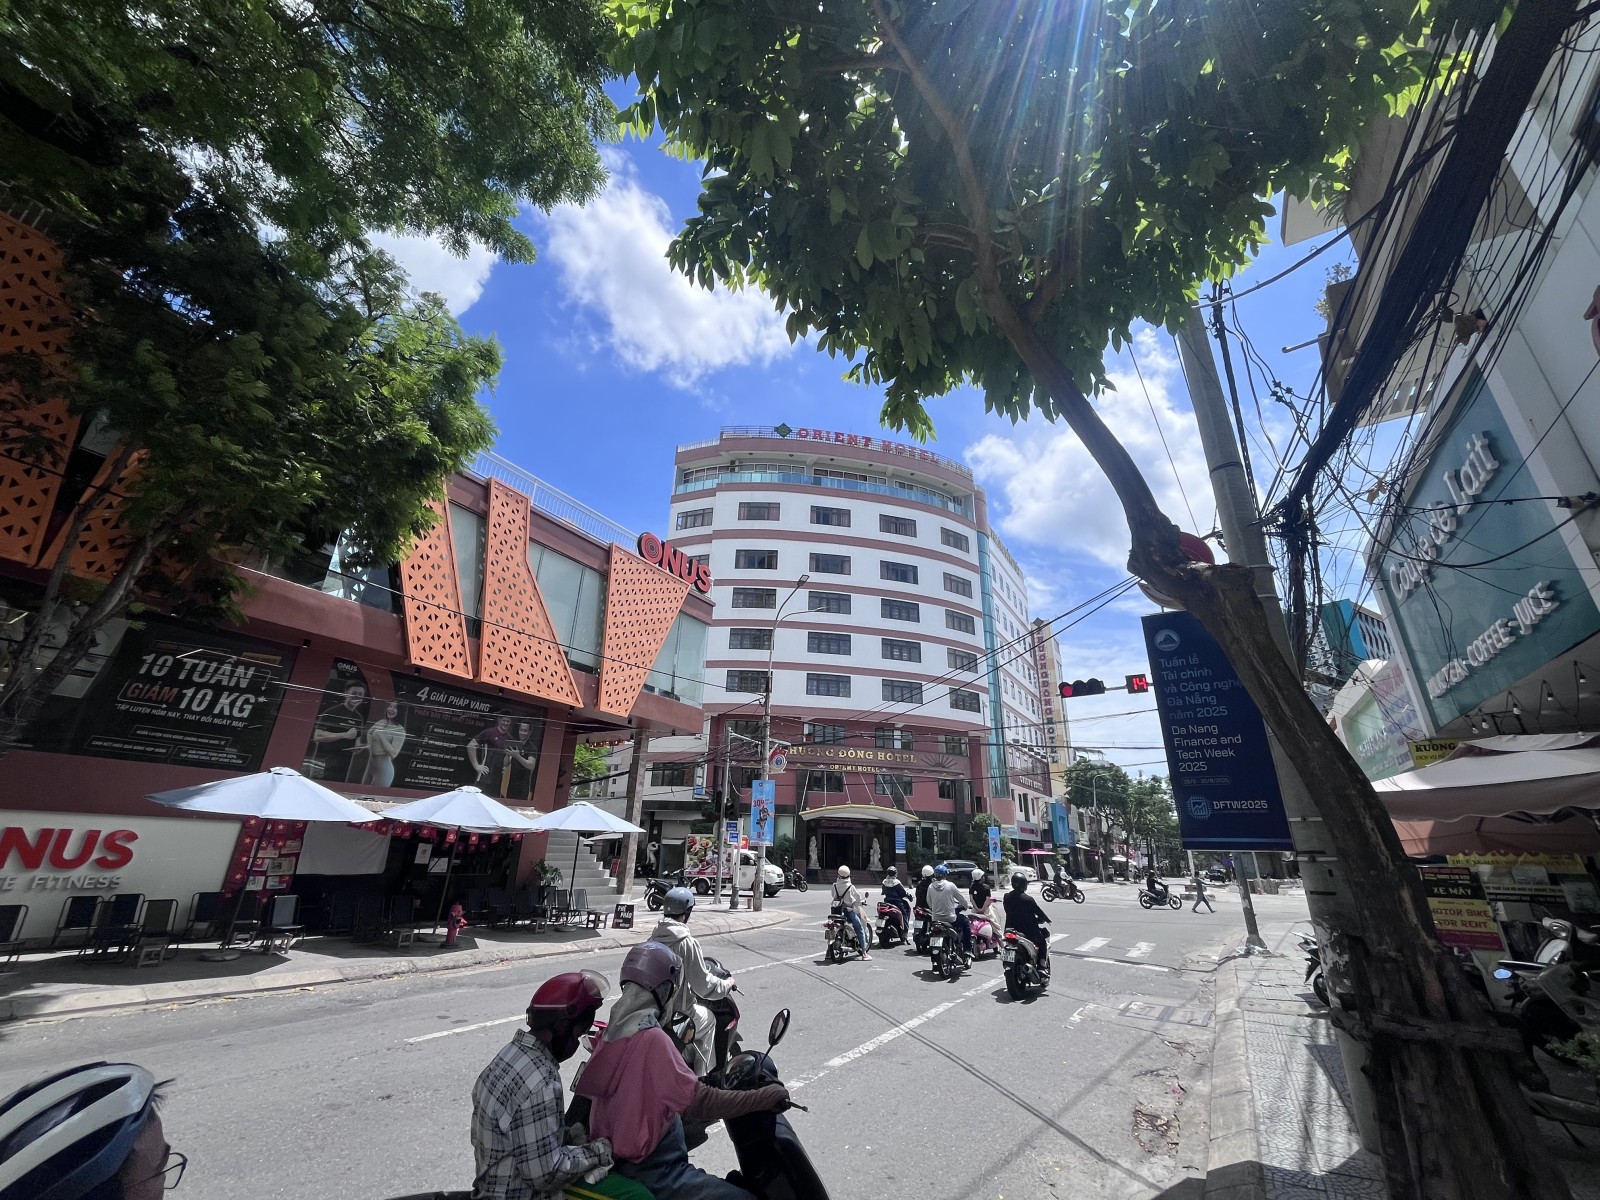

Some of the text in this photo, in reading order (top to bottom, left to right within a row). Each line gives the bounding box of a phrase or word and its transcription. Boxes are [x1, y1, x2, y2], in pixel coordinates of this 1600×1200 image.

[797, 427, 872, 448] ORIENT
[637, 531, 712, 595] ONUS
[138, 653, 174, 678] 10
[1180, 668, 1212, 679] chính
[1132, 677, 1147, 691] 14
[1180, 681, 1211, 692] Công
[179, 687, 214, 712] 10
[417, 686, 431, 702] 4
[1196, 706, 1229, 718] 2025
[1171, 724, 1219, 735] Da Nang
[1174, 734, 1243, 747] Finance and
[877, 751, 917, 763] HOTEL
[1176, 748, 1236, 760] Tech Week
[1178, 761, 1208, 772] 2025
[1213, 800, 1269, 810] DFTW2025
[0, 827, 139, 870] NUS
[31, 875, 122, 890] FITNESS
[1466, 909, 1492, 918] BIKE
[1439, 919, 1489, 929] FOR RENT
